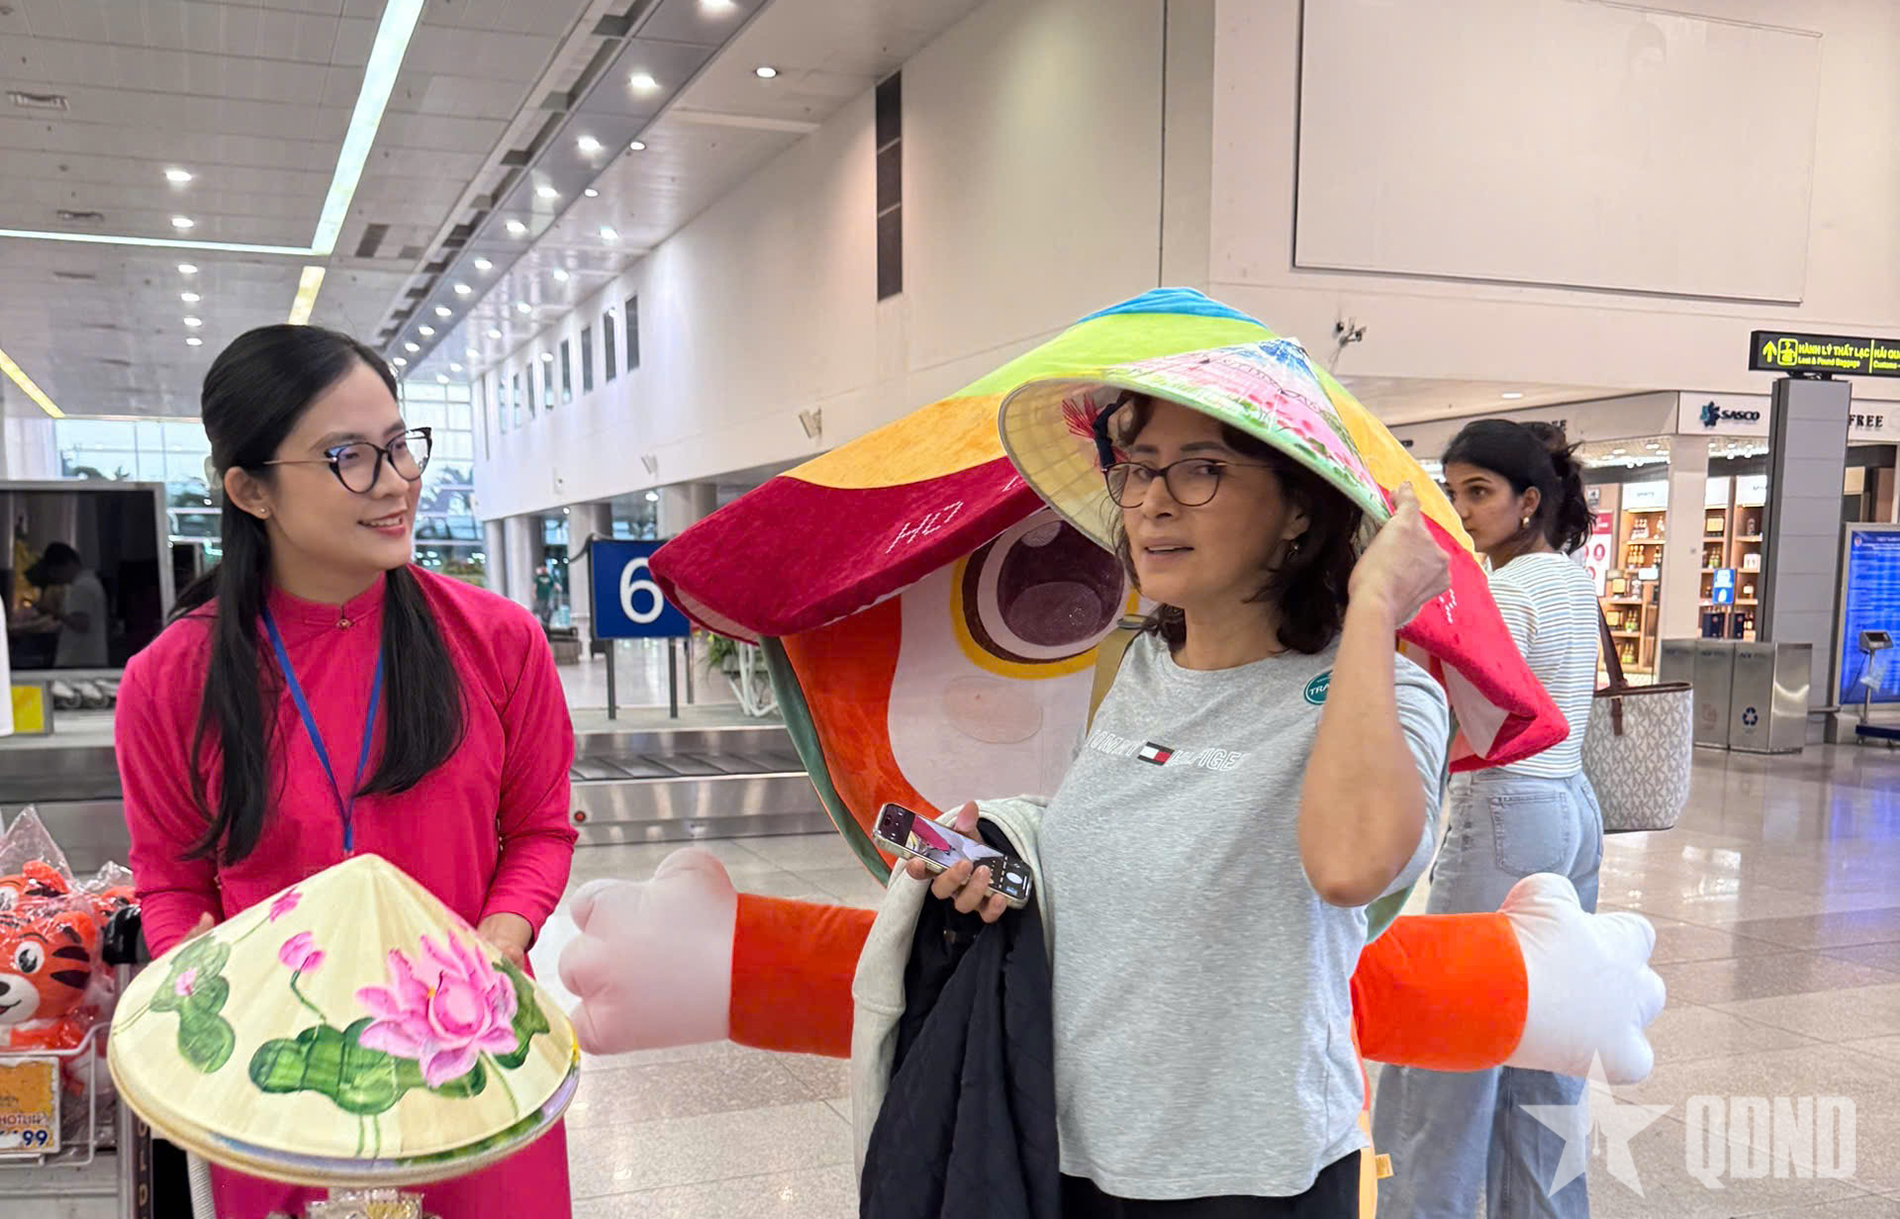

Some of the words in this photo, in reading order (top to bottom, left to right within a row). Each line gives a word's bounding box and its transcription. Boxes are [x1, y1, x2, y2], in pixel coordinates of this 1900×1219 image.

[1798, 343, 1821, 354] HÀNH
[1822, 344, 1832, 355] LÝ
[1833, 344, 1853, 357] THẤT
[1854, 349, 1869, 359] LẠC
[1798, 356, 1810, 364] Lost
[1811, 357, 1816, 365] &
[1817, 357, 1835, 367] Found
[1836, 358, 1860, 369] Baggage
[1873, 360, 1897, 369] Customs
[1720, 409, 1760, 421] SASCO
[1849, 414, 1884, 428] FREE
[619, 556, 664, 624] 6
[1309, 683, 1330, 695] TRA
